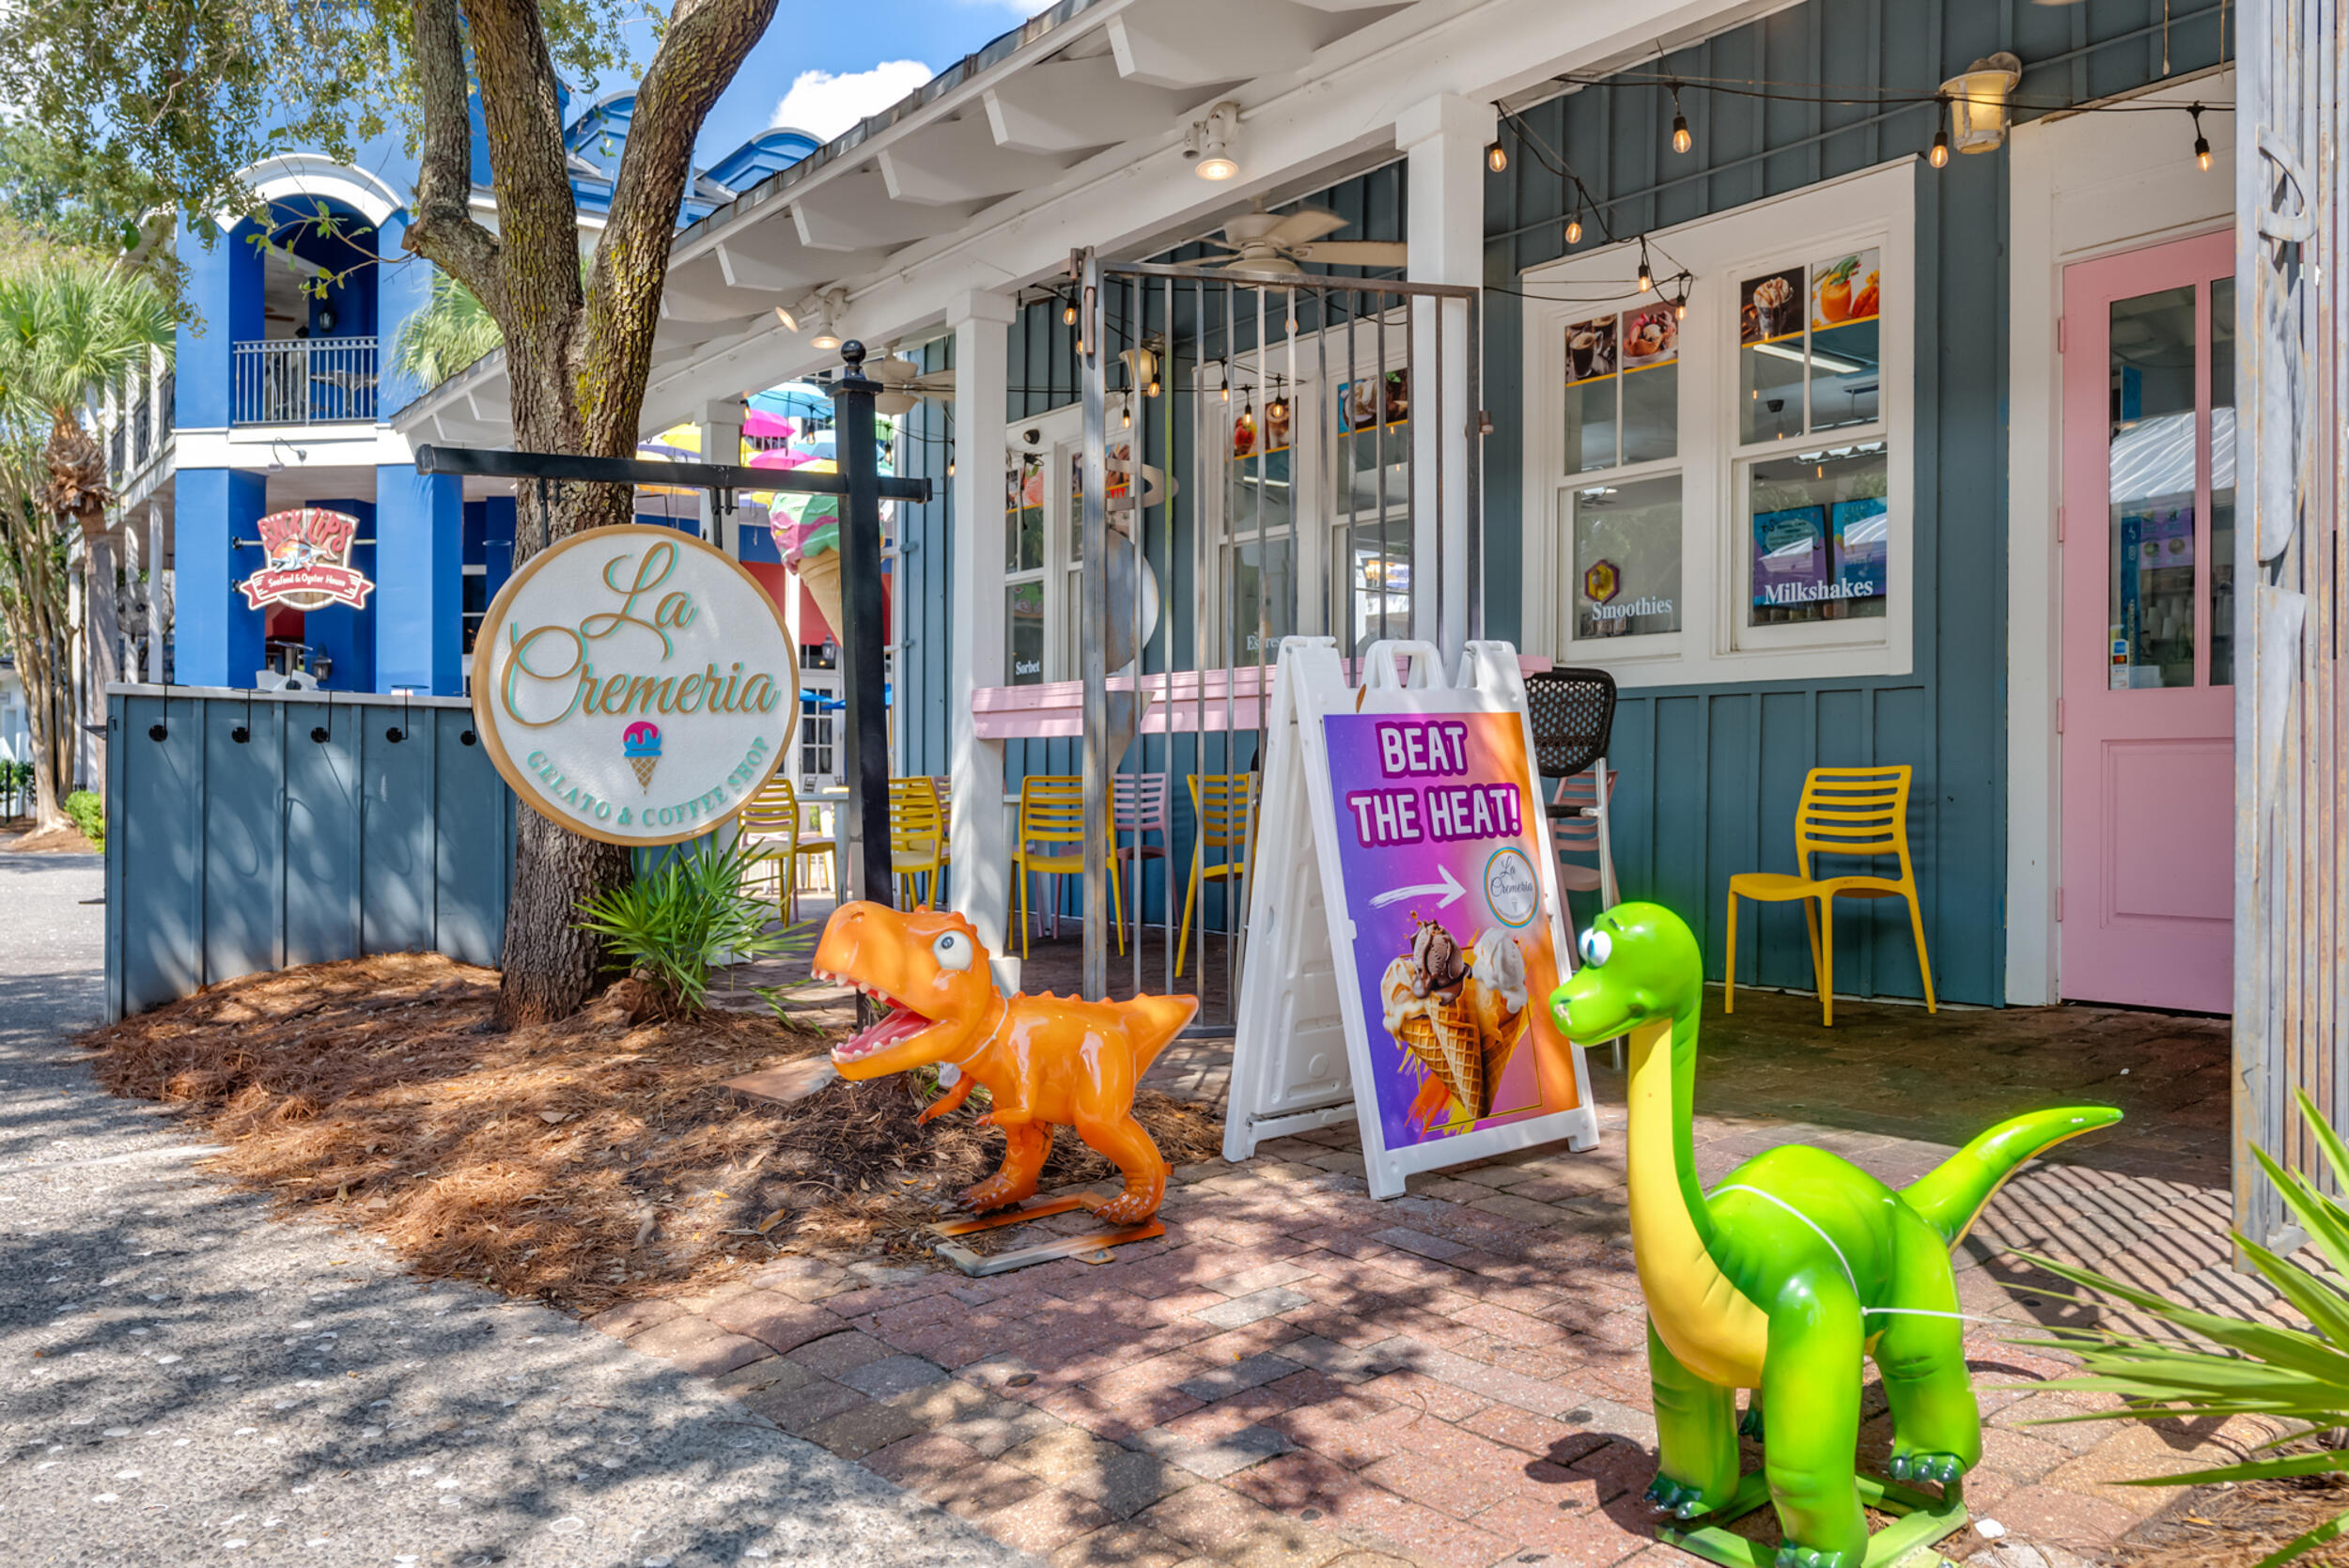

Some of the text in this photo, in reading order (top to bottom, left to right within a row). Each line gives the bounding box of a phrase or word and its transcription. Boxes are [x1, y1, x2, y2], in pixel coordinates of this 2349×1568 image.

[580, 541, 698, 661] La
[1592, 596, 1673, 621] Smoothies
[1765, 578, 1874, 605] Milkshakes
[501, 622, 781, 727] Cremeria
[1015, 660, 1040, 675] Sorbet
[1380, 726, 1464, 773] BEAT
[527, 736, 770, 827] GELATO & COFFEE SHOP
[1350, 788, 1518, 842] THE HEAT!
[1490, 877, 1533, 897] Cremeria
